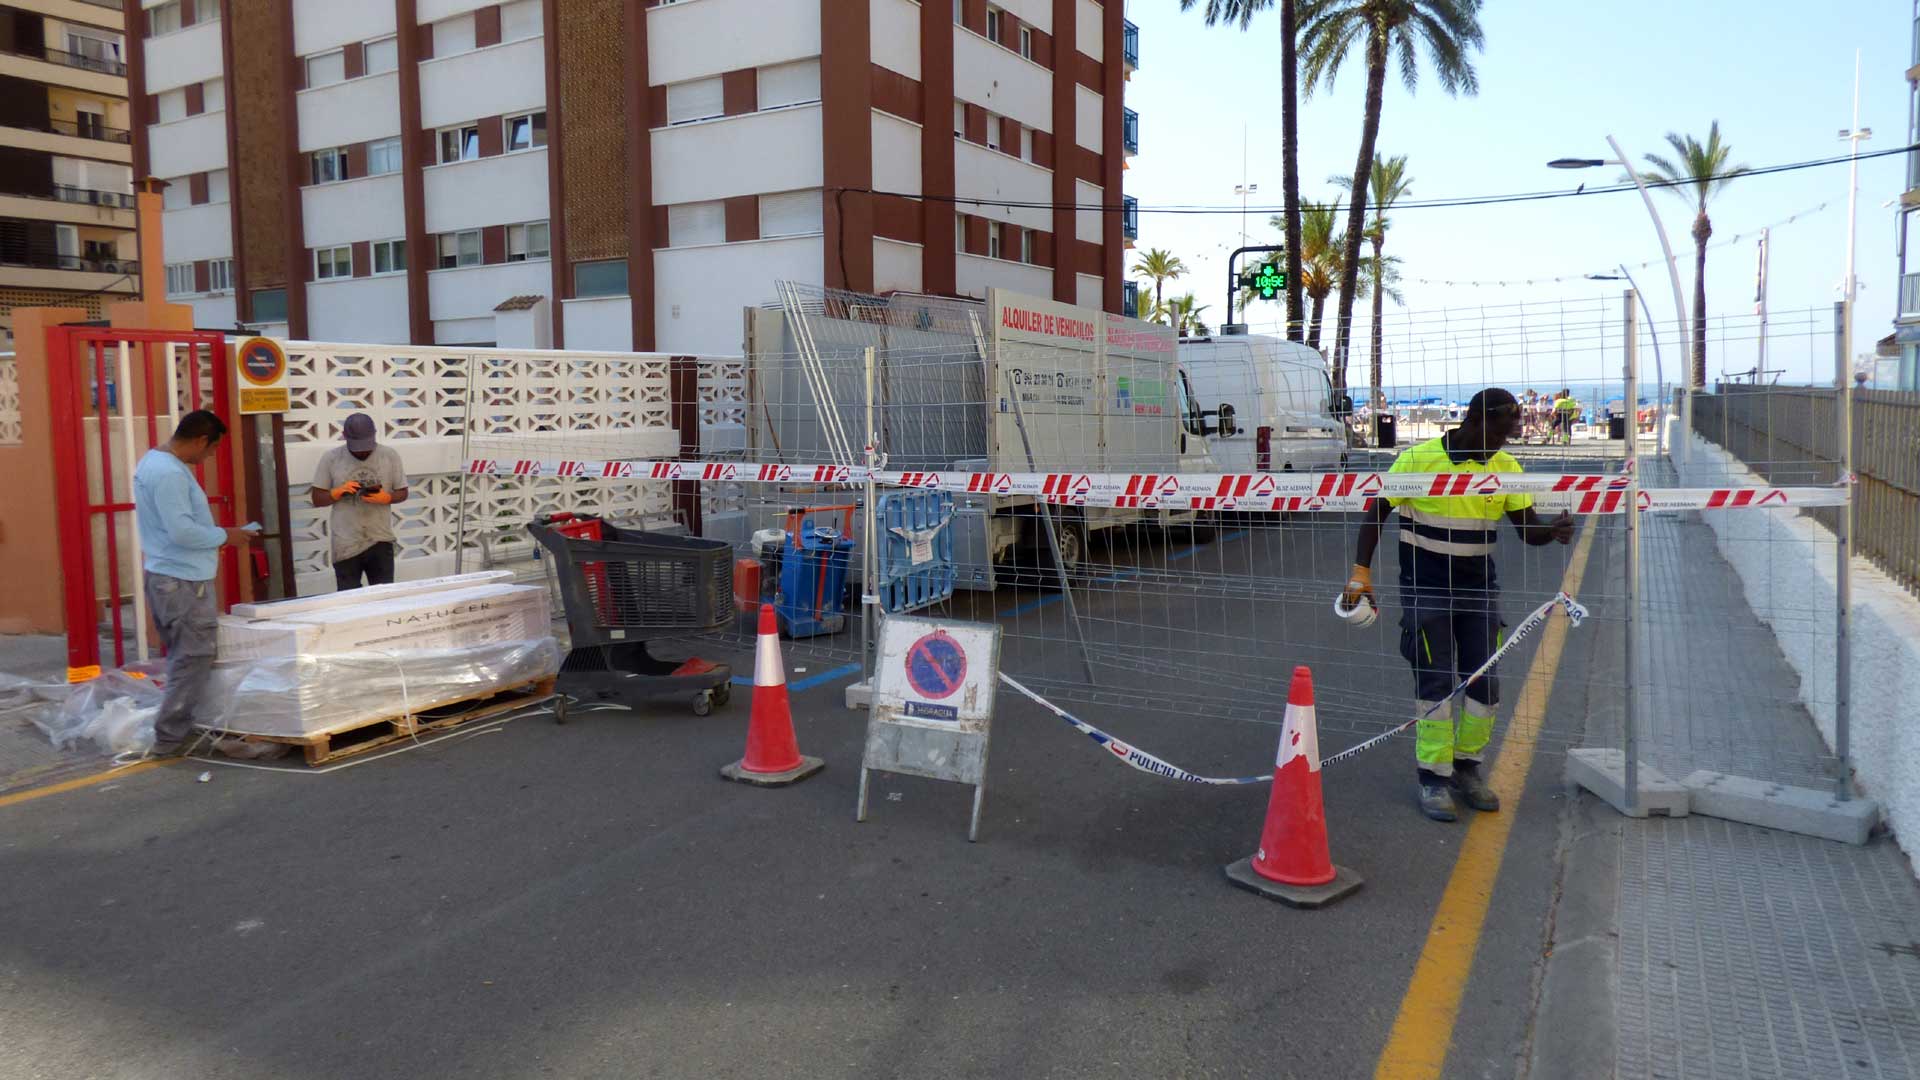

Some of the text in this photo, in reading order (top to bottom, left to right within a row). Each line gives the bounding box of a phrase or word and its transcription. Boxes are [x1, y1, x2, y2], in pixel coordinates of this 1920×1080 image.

[1002, 306, 1042, 333] ALQUILER
[1044, 315, 1054, 335] DE
[1055, 317, 1095, 341] VEHICULOS
[385, 602, 491, 627] NATUCER
